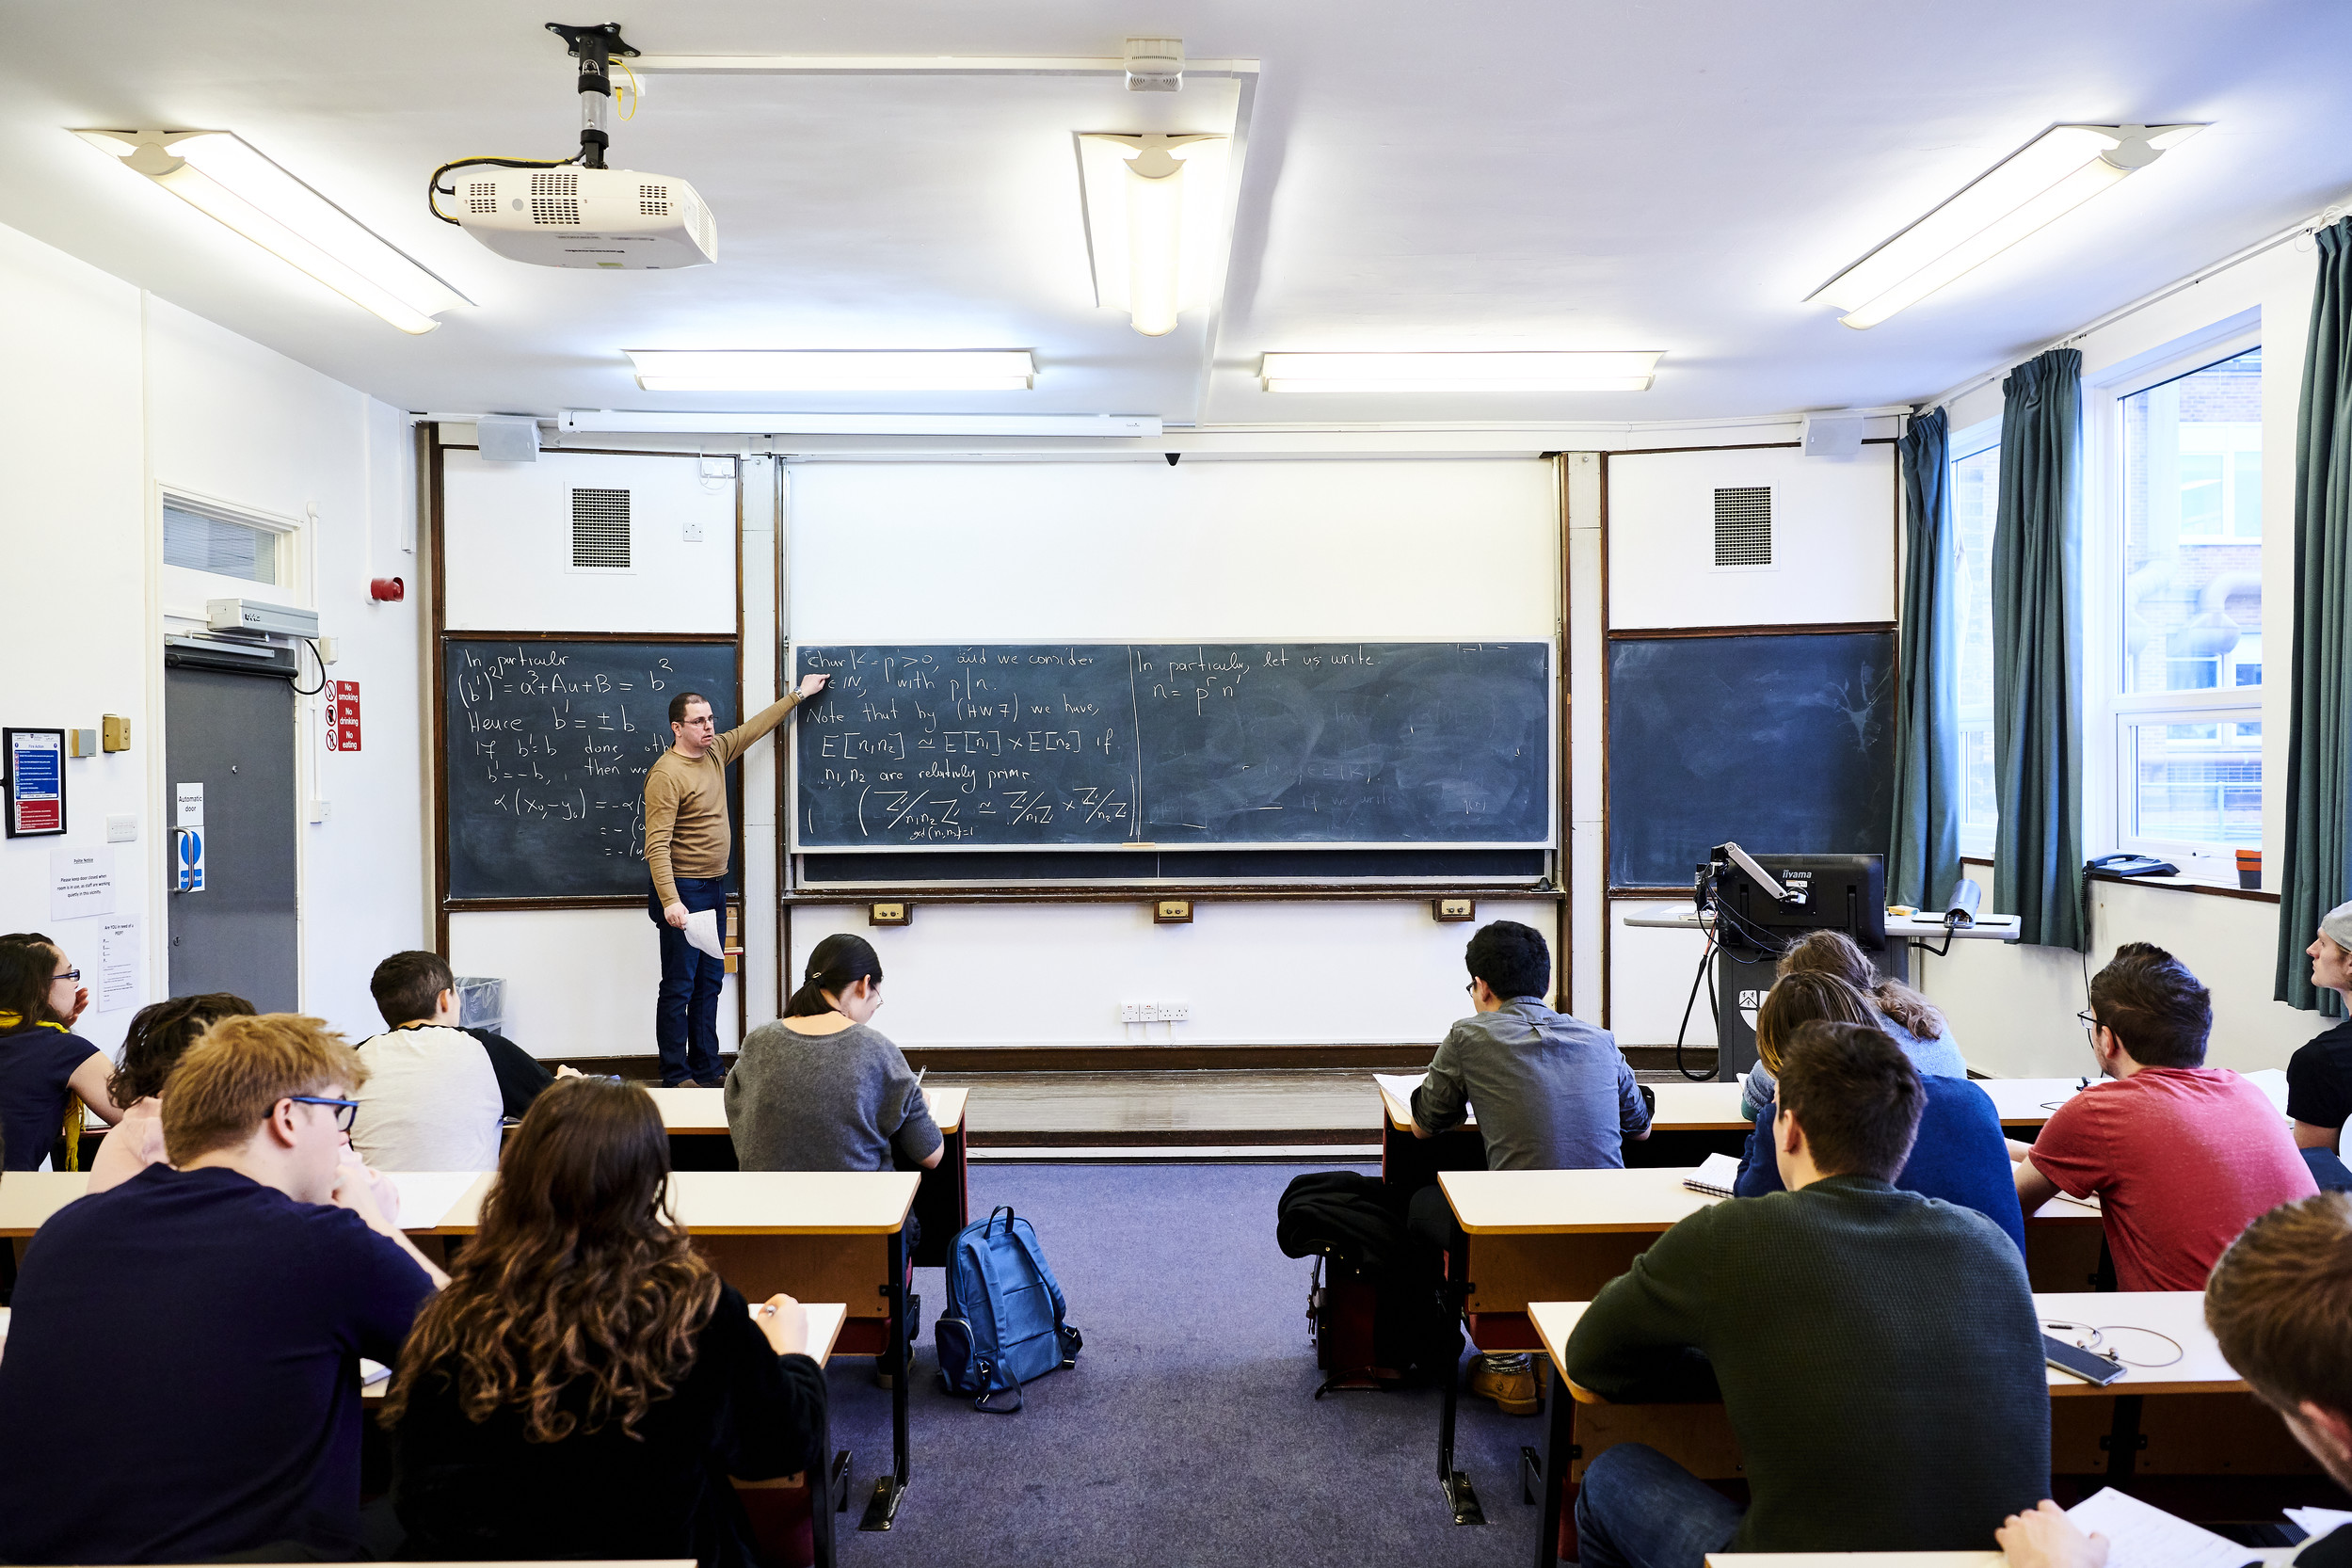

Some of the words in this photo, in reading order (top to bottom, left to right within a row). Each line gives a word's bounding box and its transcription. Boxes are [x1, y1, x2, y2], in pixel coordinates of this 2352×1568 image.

[465, 649, 481, 667] In
[998, 654, 1019, 664] we
[1029, 648, 1094, 665] consider
[1137, 650, 1153, 672] In
[1263, 648, 1289, 667] let
[1303, 656, 1320, 665] us
[897, 670, 935, 689] with
[344, 682, 352, 692] No
[338, 693, 359, 703] smoking
[340, 717, 359, 727] drinking
[468, 712, 523, 732] Hence
[807, 701, 845, 724] Note
[862, 698, 898, 722] that
[915, 701, 936, 733] by
[1031, 706, 1051, 714] we
[345, 730, 353, 739] No
[342, 741, 358, 750] eating
[1096, 728, 1113, 755] if
[584, 758, 620, 776] then
[879, 774, 904, 782] are
[179, 794, 202, 803] Automatic
[1782, 869, 1812, 879] iiyama
